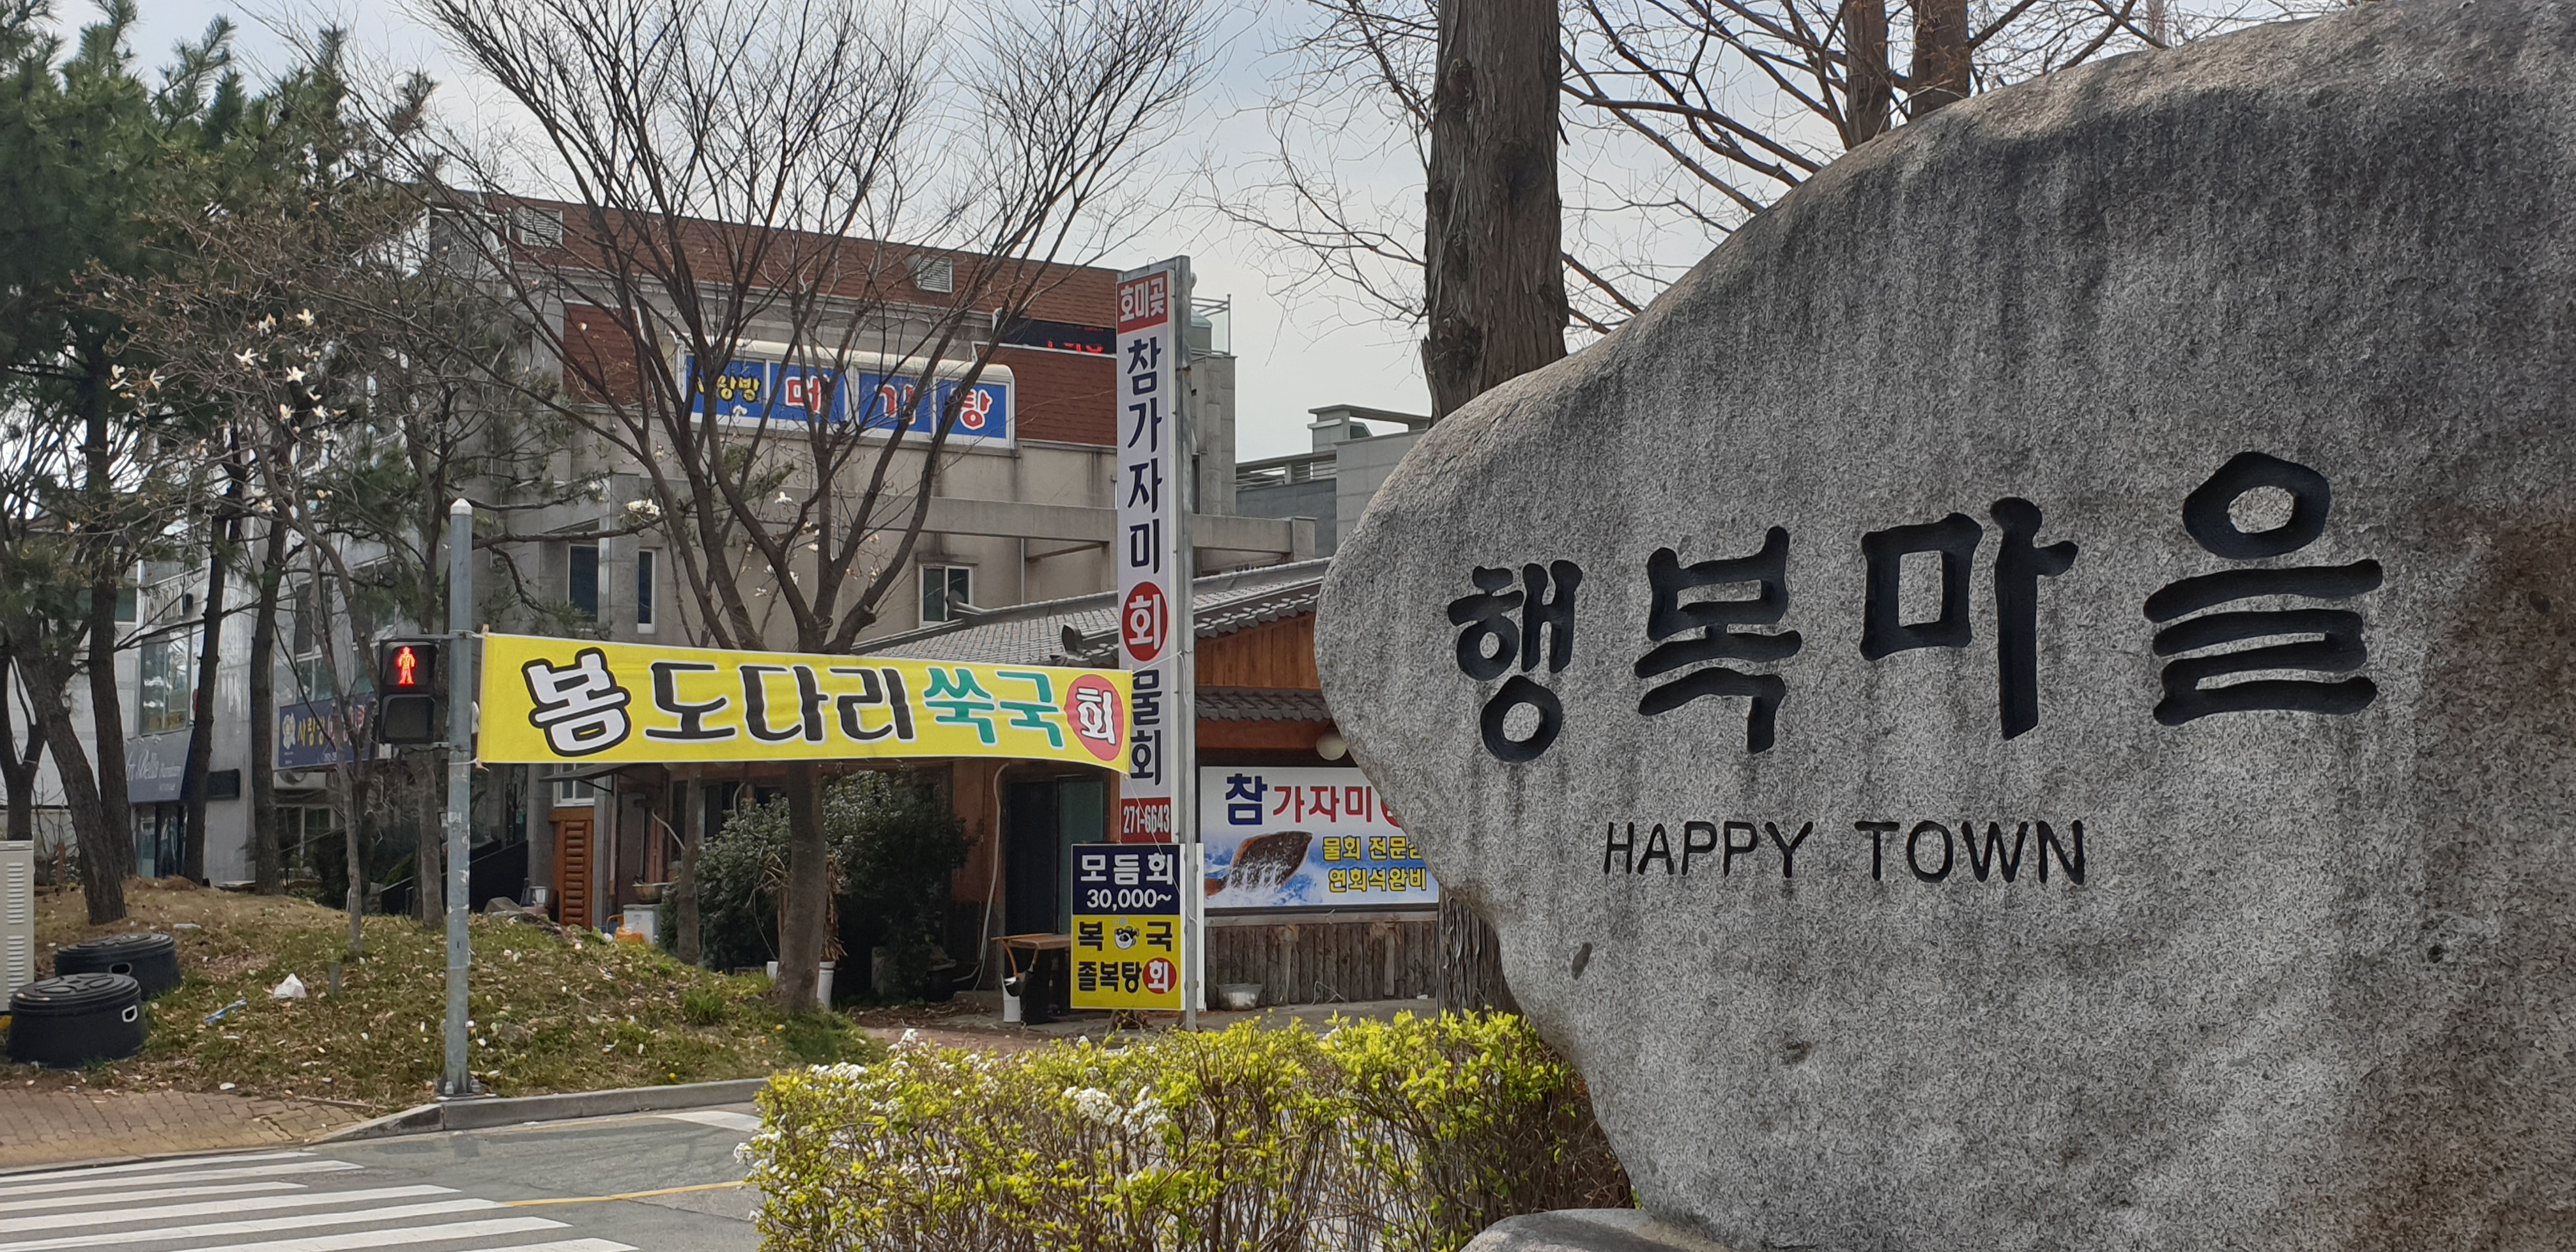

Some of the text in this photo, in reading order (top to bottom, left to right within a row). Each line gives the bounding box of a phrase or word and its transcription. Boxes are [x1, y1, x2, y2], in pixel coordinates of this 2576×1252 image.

[1119, 275, 1165, 323] 호미곶
[696, 374, 762, 403] 랑방
[521, 646, 1117, 758] 봄 도다리 쑥국 회
[1130, 669, 1162, 786] 물회
[1123, 804, 1171, 835] 271-6643
[1322, 836, 1361, 862] 물회
[1602, 820, 2085, 884] HAPPY TOWN
[1080, 853, 1174, 885] 모듬회
[1328, 866, 1427, 894] 연회석완비
[1087, 889, 1172, 912] 30,000~
